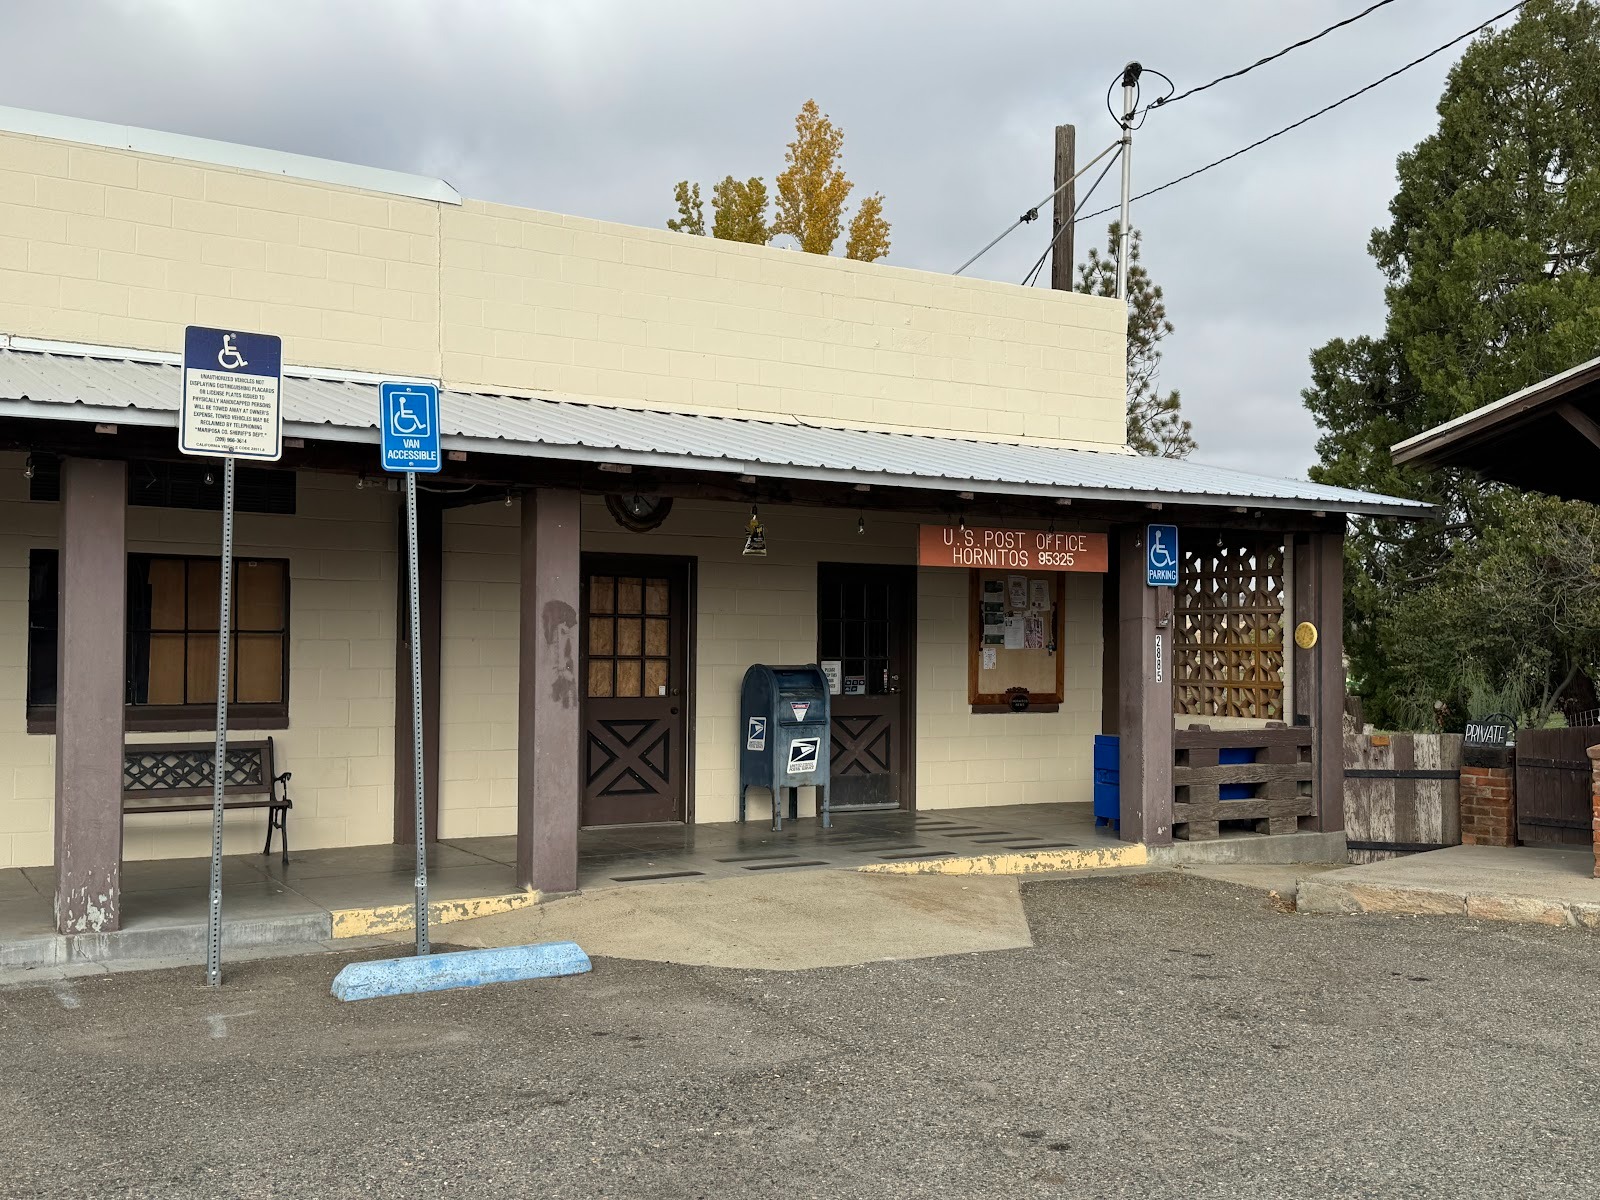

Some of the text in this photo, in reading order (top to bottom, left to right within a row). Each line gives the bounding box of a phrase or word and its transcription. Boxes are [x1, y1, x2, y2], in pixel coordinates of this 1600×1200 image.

[201, 374, 233, 382] UNAUTHORIZED
[190, 380, 275, 394] DISPLAYING DISTINGUISHING PLACARDS
[192, 396, 220, 404] PHYSICALLY
[220, 399, 251, 407] HANDICAPPED
[403, 439, 420, 449] VAN
[387, 450, 437, 461] ACCESSIBLE
[984, 531, 1026, 549] POST
[1036, 533, 1087, 552] OFFICE
[953, 547, 1075, 567] HORNITOS 95325
[1149, 570, 1176, 581] PARKING
[1465, 724, 1506, 743] PRIVATE
